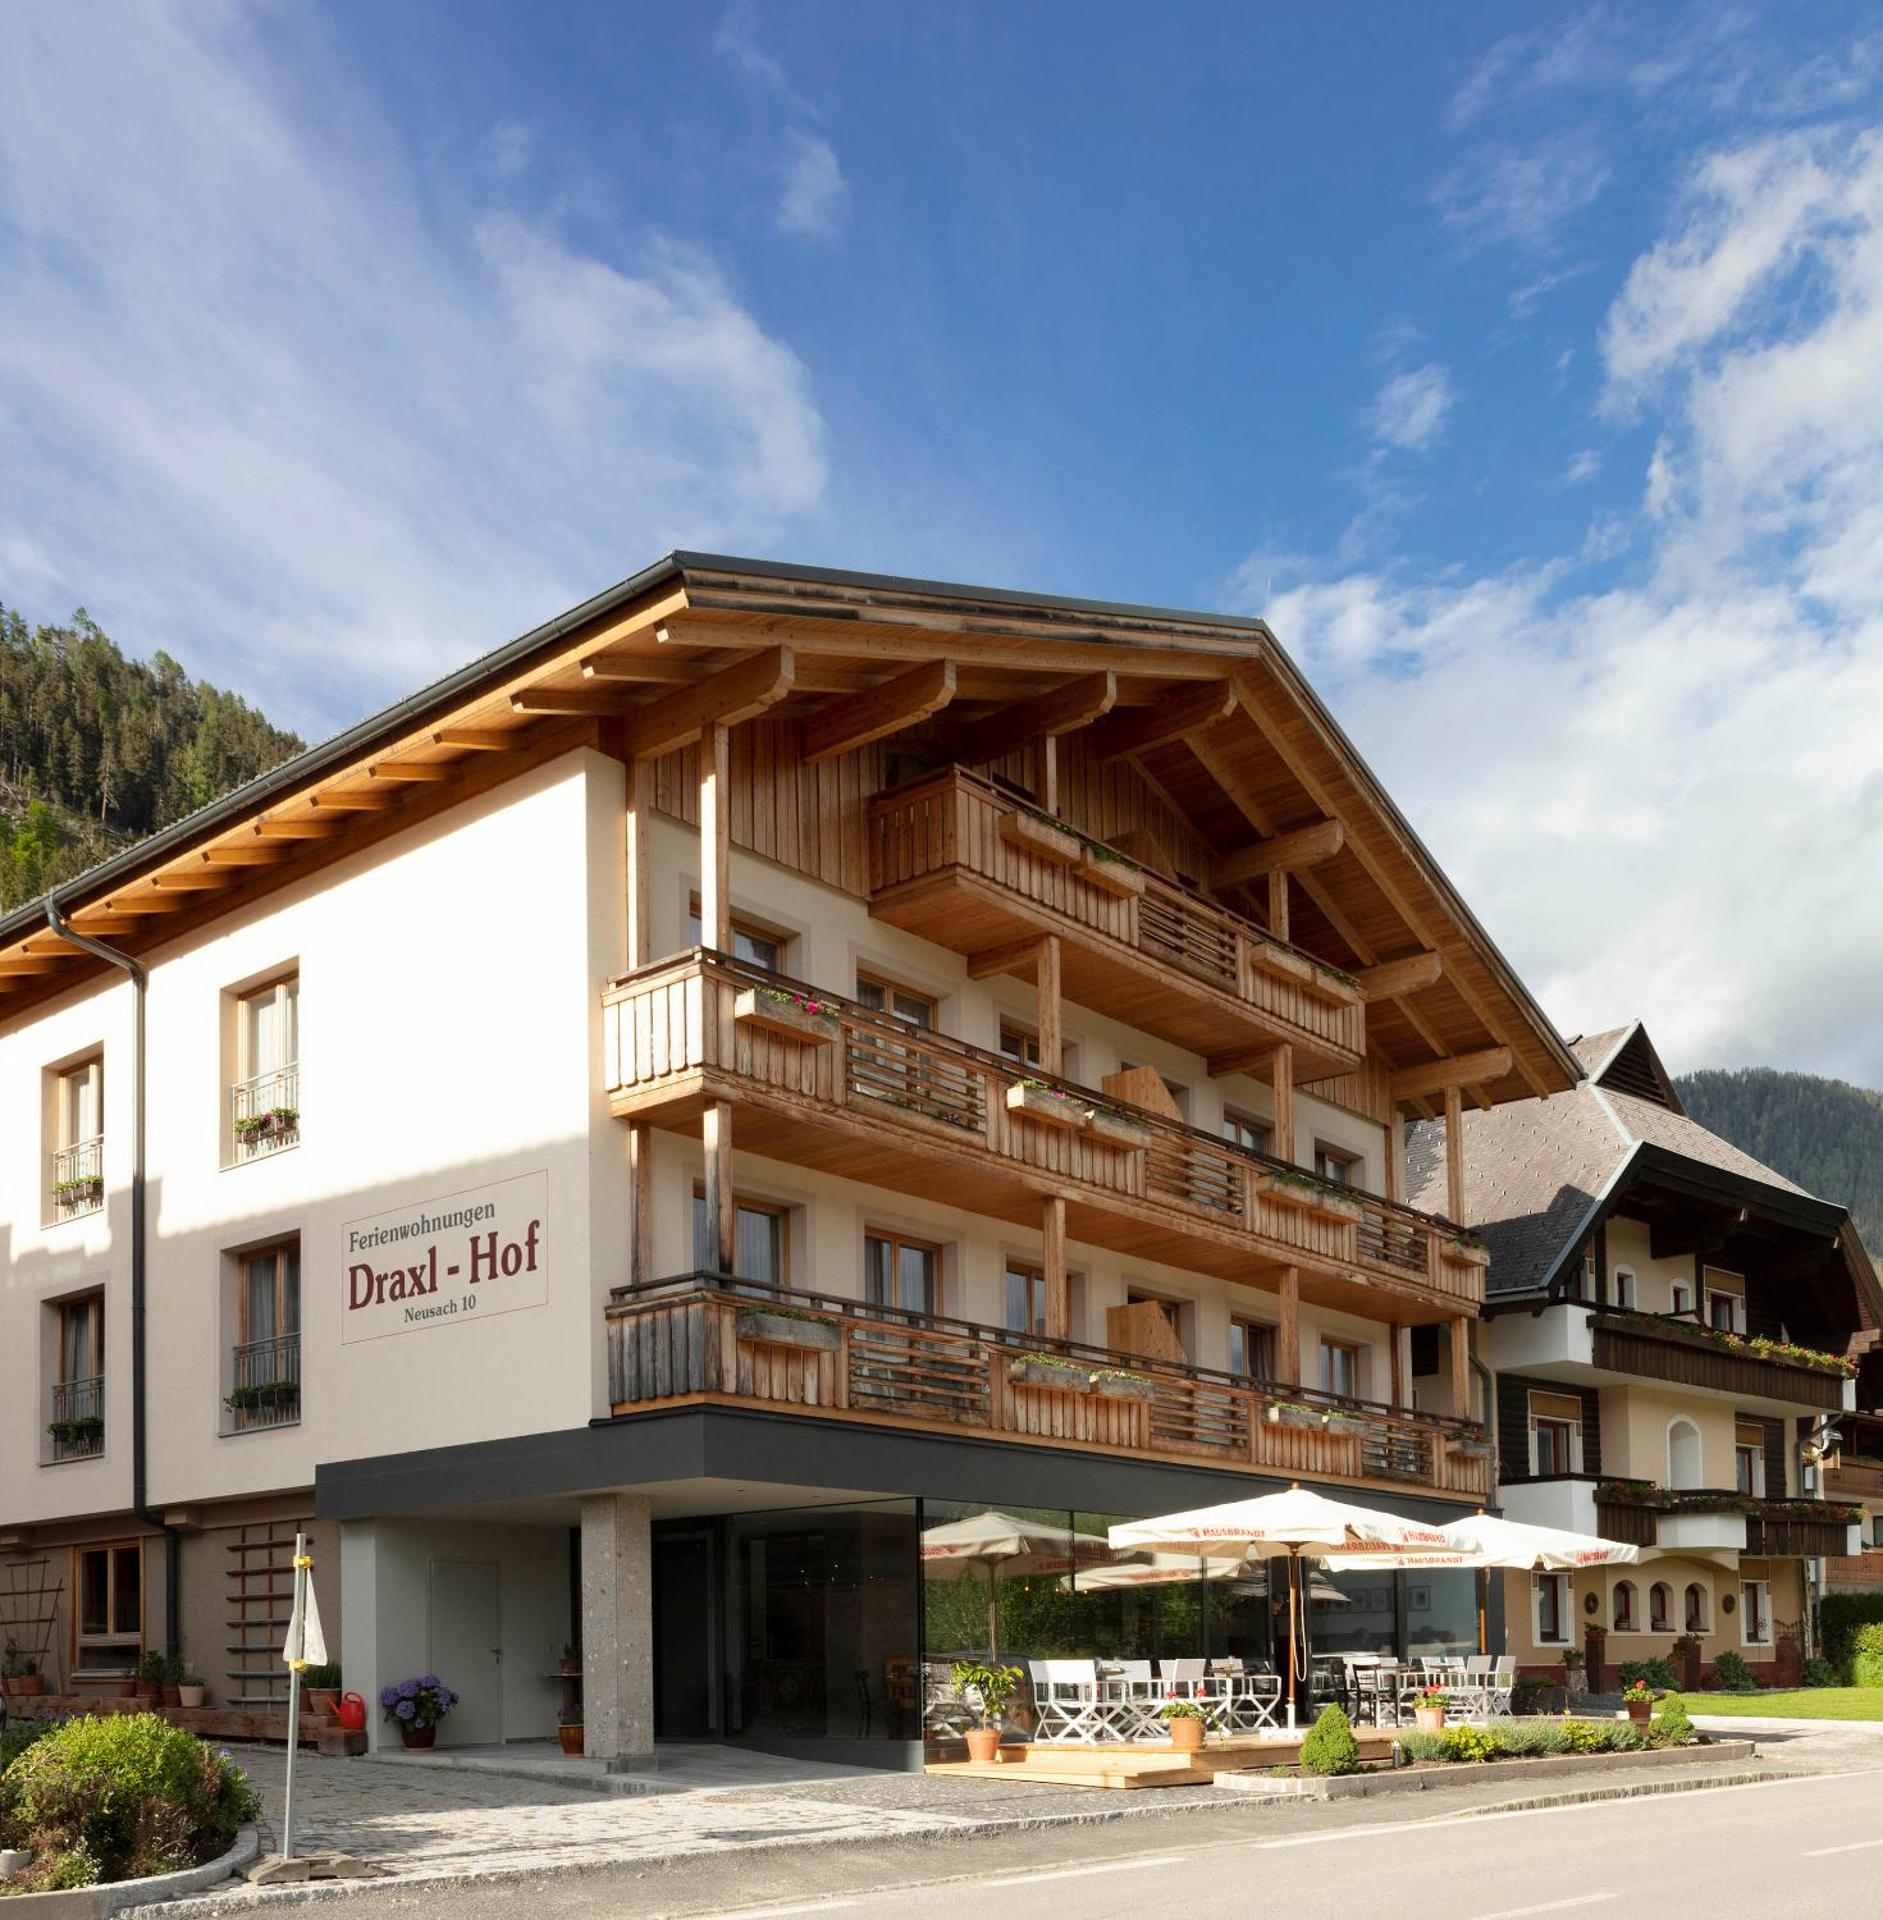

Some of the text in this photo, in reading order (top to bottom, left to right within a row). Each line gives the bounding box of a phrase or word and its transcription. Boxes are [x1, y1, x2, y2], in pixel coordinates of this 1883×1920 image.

[349, 1203, 495, 1252] Ferienwohnungen
[349, 1245, 438, 1310] Draxl
[469, 1219, 540, 1284] Hof
[404, 1294, 476, 1323] Neusach 10
